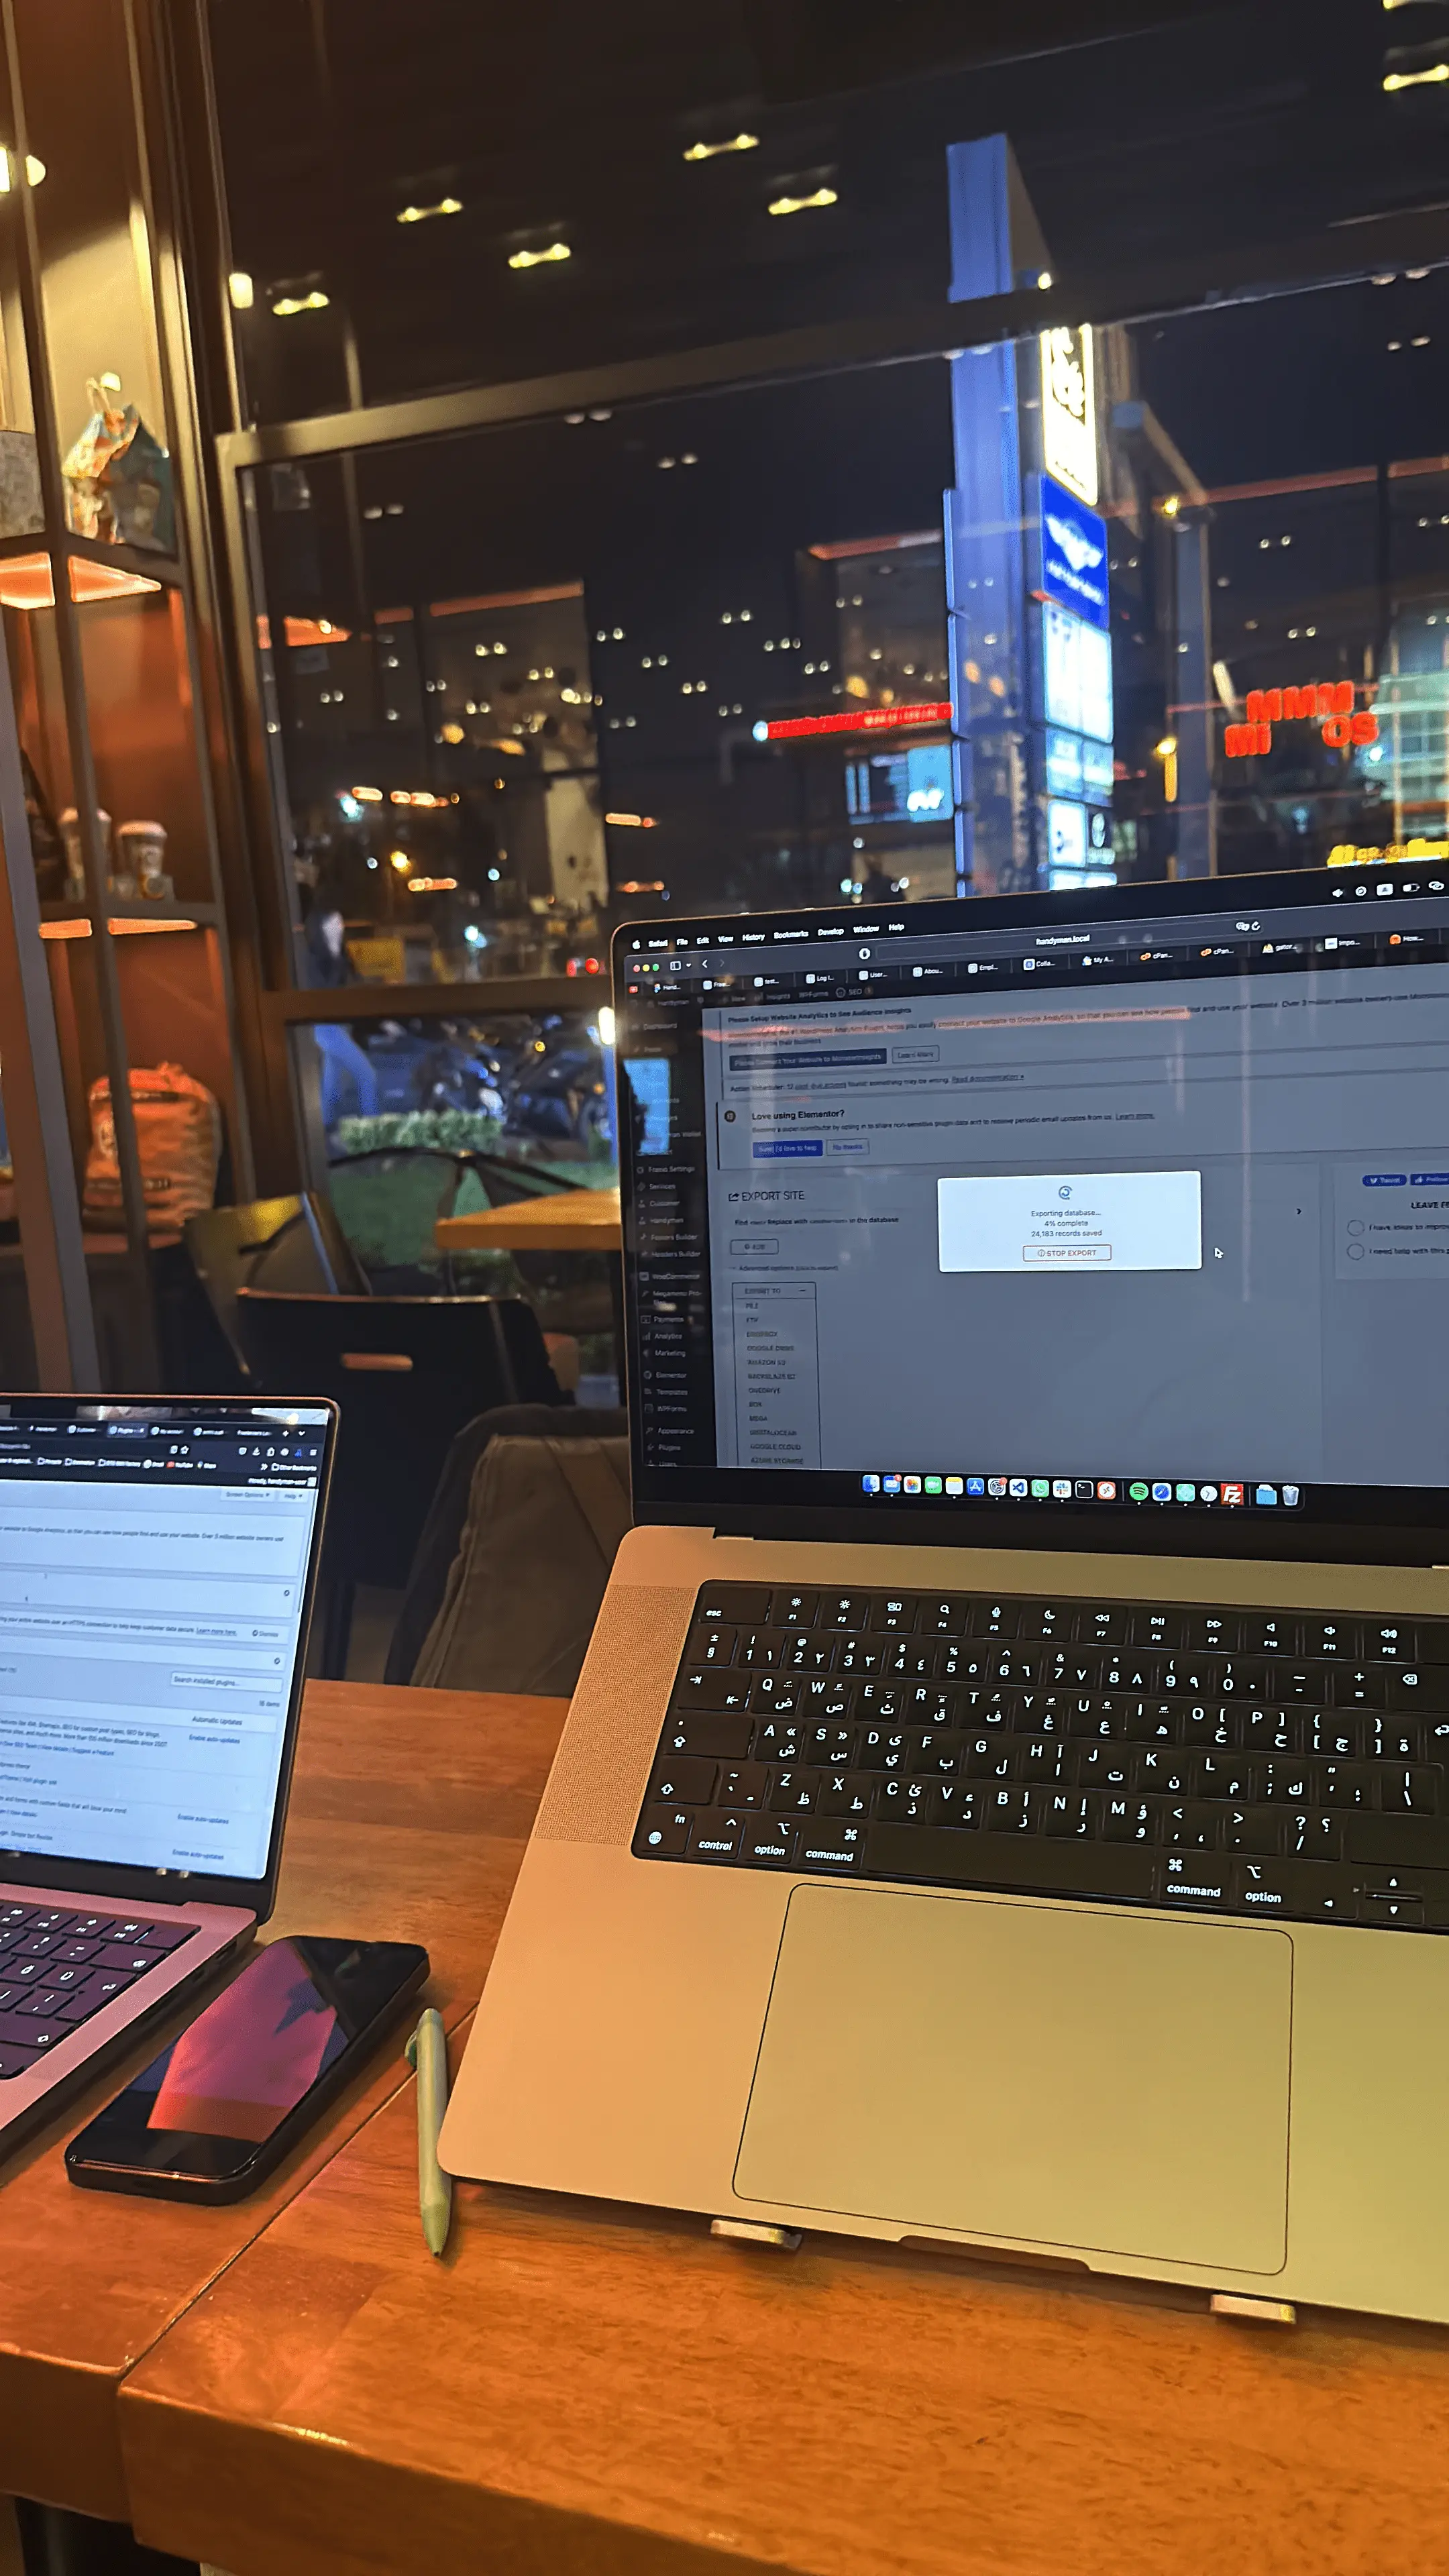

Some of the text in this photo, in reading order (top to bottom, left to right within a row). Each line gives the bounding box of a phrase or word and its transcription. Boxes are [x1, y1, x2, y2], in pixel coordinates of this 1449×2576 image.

[649, 940, 668, 948] Safari
[718, 935, 734, 943] View
[742, 933, 765, 942] History
[773, 930, 809, 939] Bookmarks
[818, 928, 845, 936] Develop
[853, 925, 879, 934] Window
[888, 924, 905, 932] Help
[752, 1110, 845, 1121] Love using Elementor?
[742, 1191, 805, 1201] EXPORT SITE
[747, 1649, 753, 1660] 1
[1382, 1646, 1397, 1654] F12
[794, 1652, 804, 1663] 2
[843, 1654, 853, 1666] 3
[894, 1658, 904, 1670] 4
[946, 1661, 956, 1673] 5
[1000, 1664, 1010, 1676] 6
[1055, 1668, 1064, 1679] 7
[1109, 1671, 1120, 1683] 8
[1165, 1674, 1176, 1687] 9
[762, 1678, 773, 1691] Q
[811, 1681, 826, 1694] W
[864, 1684, 874, 1697] E
[1223, 1678, 1234, 1690] 0
[916, 1688, 926, 1701] R
[969, 1692, 979, 1704] T
[775, 1697, 793, 1709] ض
[1024, 1695, 1034, 1708] Y
[1078, 1699, 1089, 1712] U
[826, 1704, 844, 1713] ص
[880, 1703, 894, 1715] ث
[934, 1709, 946, 1721] ق
[1192, 1707, 1204, 1720] O
[986, 1710, 1002, 1722] ف
[1043, 1714, 1054, 1730] غ
[1252, 1711, 1263, 1724] P
[763, 1724, 775, 1737] A
[816, 1728, 827, 1741] S
[1099, 1721, 1110, 1735] ع
[867, 1731, 879, 1744] D
[1215, 1727, 1228, 1743] خ
[1275, 1733, 1287, 1748] ح
[922, 1736, 932, 1748] F
[975, 1740, 987, 1753] G
[1336, 1737, 1348, 1752] ج
[779, 1743, 796, 1758] ش
[830, 1752, 847, 1761] س
[1030, 1744, 1043, 1758] H
[1088, 1749, 1098, 1762] J
[939, 1759, 954, 1770] ب
[1146, 1753, 1157, 1767] K
[1205, 1758, 1216, 1771] L
[780, 1773, 792, 1786] Z
[1108, 1771, 1124, 1781] ت
[1169, 1776, 1180, 1789] ن
[832, 1777, 845, 1790] X
[887, 1782, 898, 1795] C
[1288, 1782, 1303, 1795] ك
[942, 1786, 953, 1800] V
[997, 1791, 1008, 1805] B
[1054, 1796, 1066, 1810] N
[1111, 1801, 1126, 1815] M
[675, 1814, 686, 1824] fn
[698, 1841, 733, 1851] control
[754, 1845, 786, 1856] option
[805, 1850, 854, 1862] command
[1167, 1884, 1222, 1897] command
[1245, 1892, 1282, 1903] option
